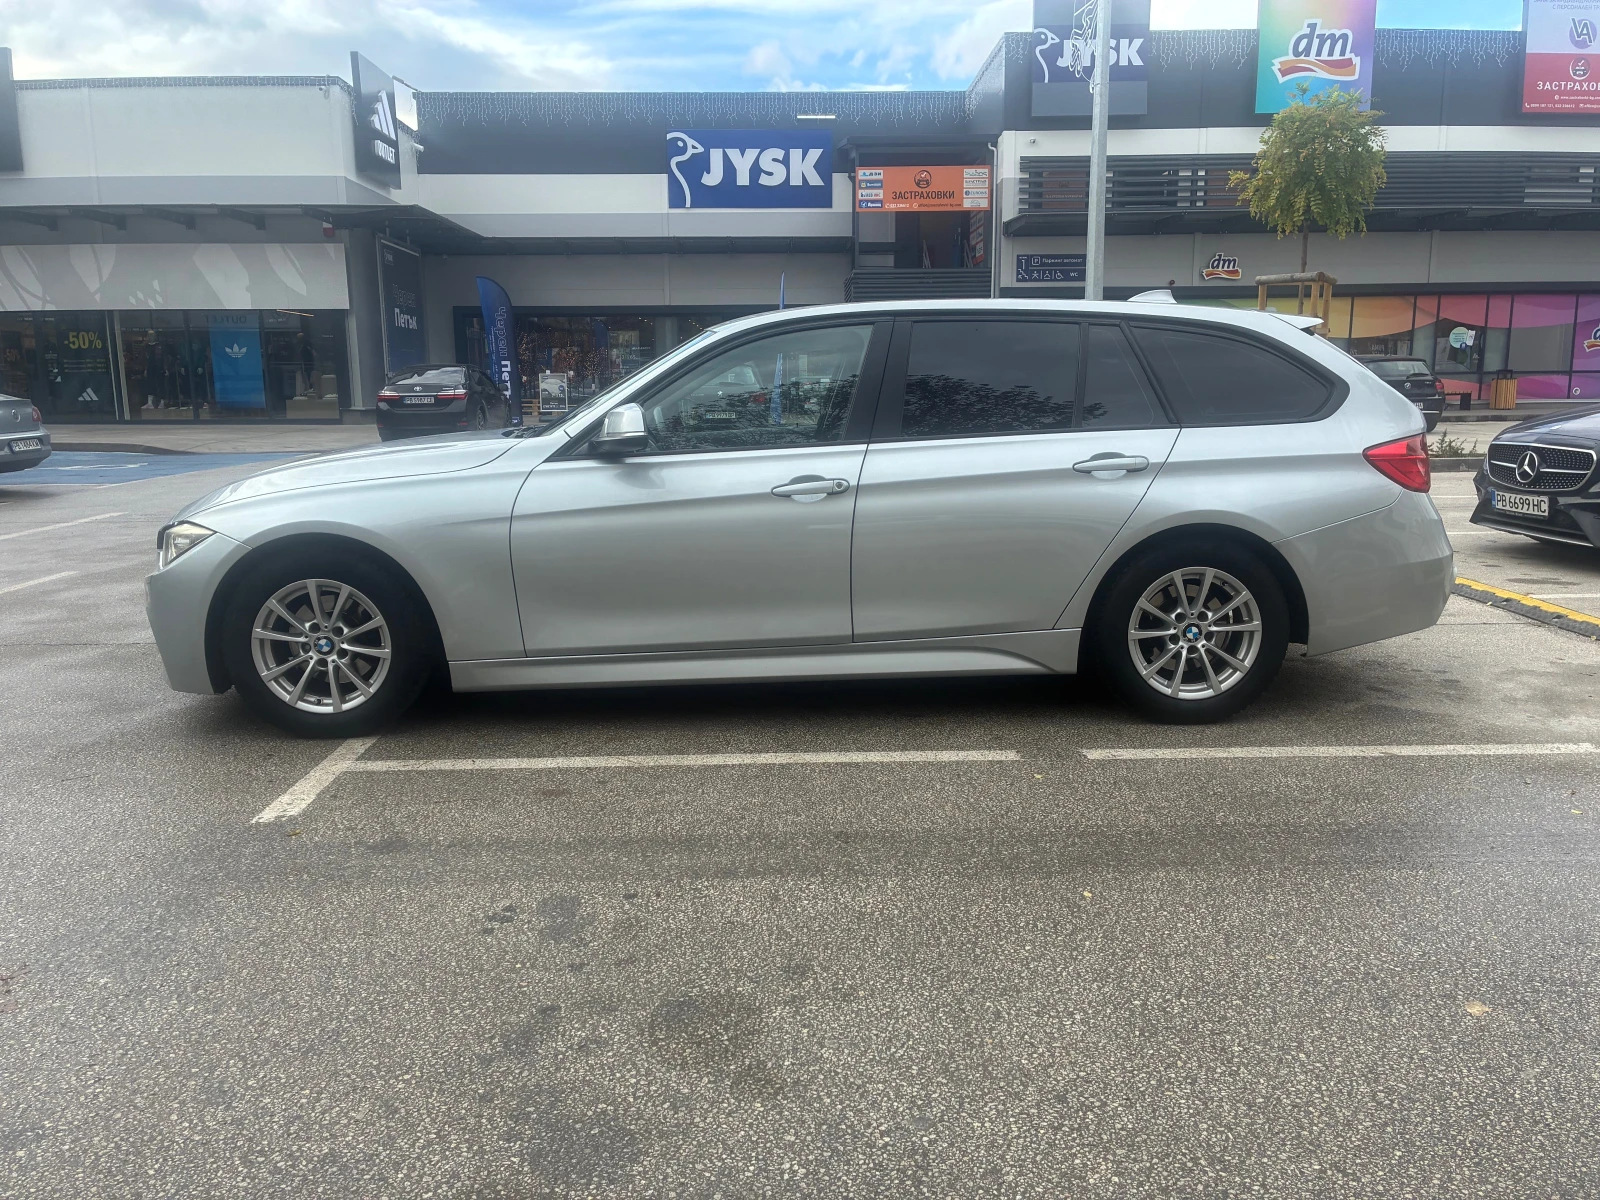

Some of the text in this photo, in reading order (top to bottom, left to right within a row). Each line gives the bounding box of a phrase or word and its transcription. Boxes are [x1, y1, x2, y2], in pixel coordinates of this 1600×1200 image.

[1292, 22, 1349, 58] dm
[700, 148, 825, 186] JYSK
[892, 190, 955, 200] ЗАСТРАХОВКИ
[1210, 254, 1237, 269] dm
[394, 308, 418, 330] Петък
[64, 332, 102, 349] -50%
[1496, 494, 1546, 513] PB 6699 HC
